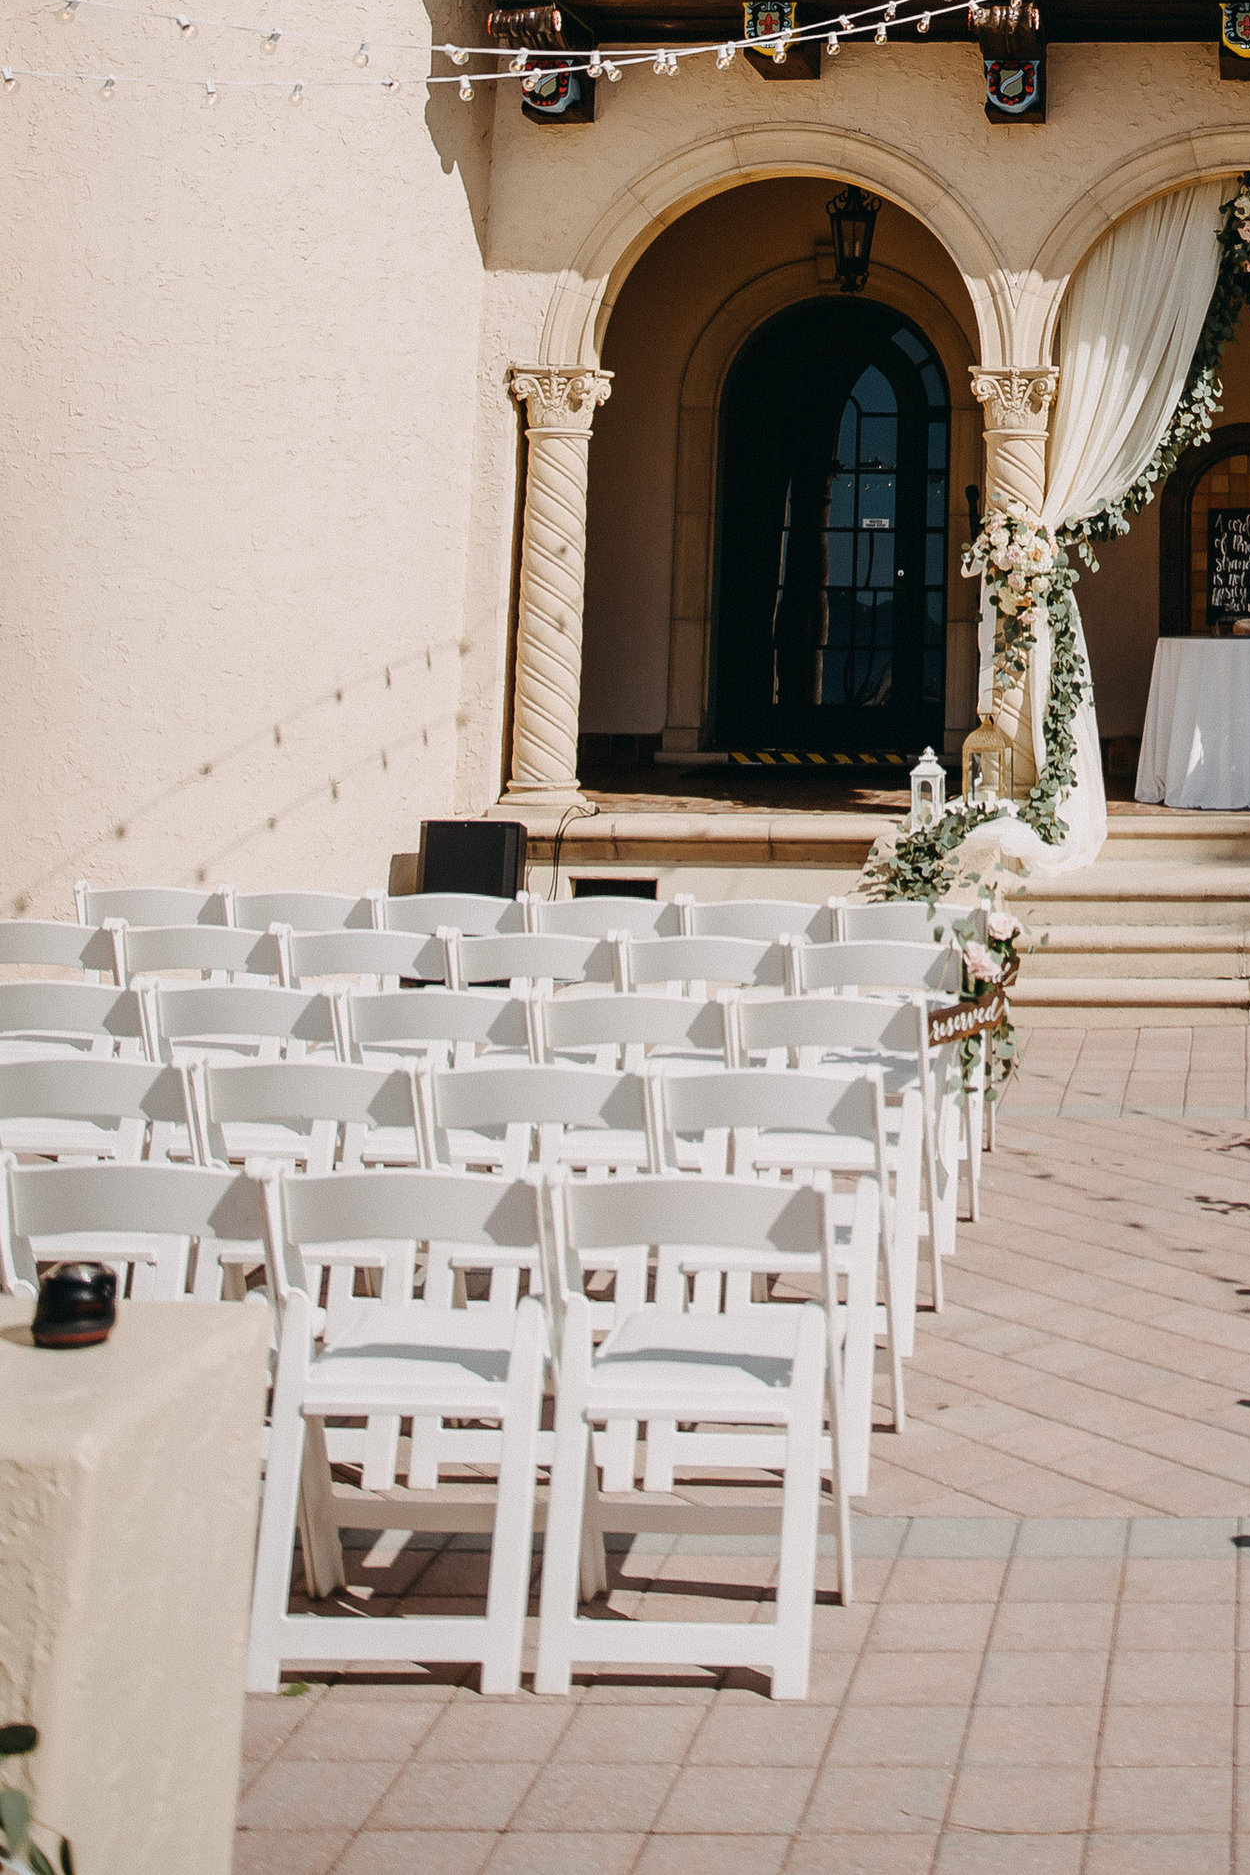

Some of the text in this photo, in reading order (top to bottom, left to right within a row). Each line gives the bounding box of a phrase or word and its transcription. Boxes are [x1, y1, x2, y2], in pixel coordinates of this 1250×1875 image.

[1214, 532, 1228, 554] of
[1212, 571, 1246, 587] is not
[929, 995, 1004, 1041] reserved
